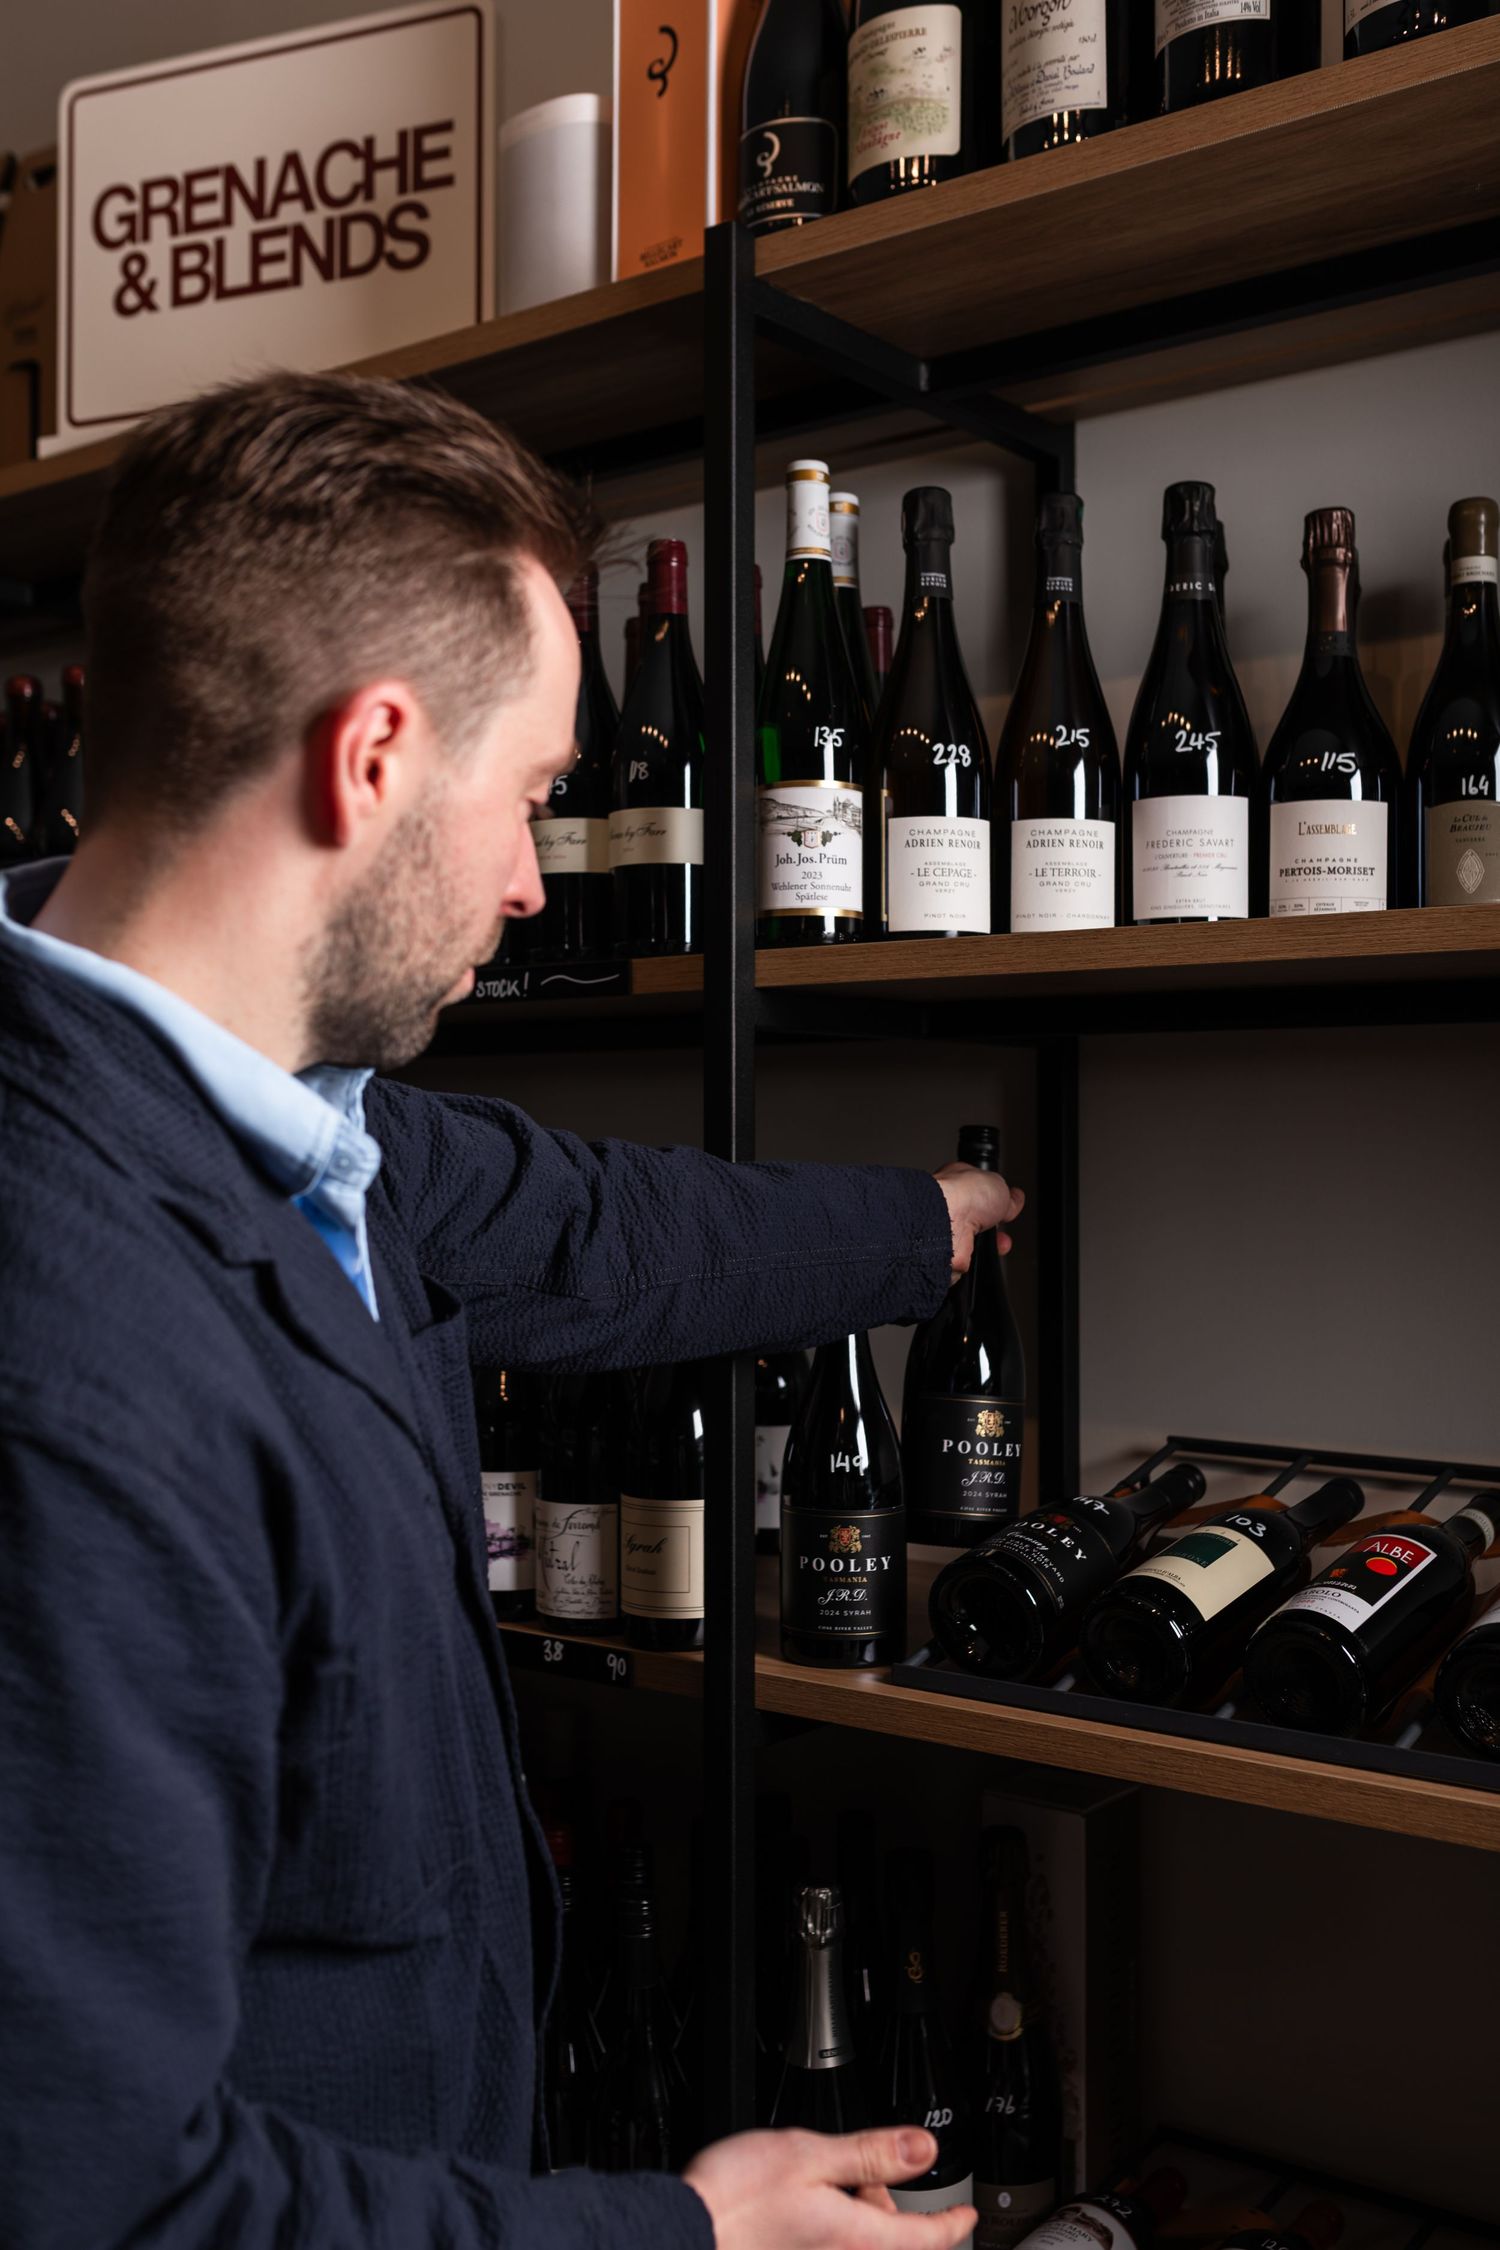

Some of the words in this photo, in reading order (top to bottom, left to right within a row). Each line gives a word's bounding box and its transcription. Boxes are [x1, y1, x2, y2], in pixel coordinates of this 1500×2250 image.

[92, 120, 455, 250] GRENACHE
[113, 251, 160, 319] &
[170, 201, 431, 308] BLENDS
[814, 726, 845, 747] 135
[1055, 725, 1090, 748] 215
[1174, 730, 1221, 753] 245
[932, 744, 971, 767] 228
[1320, 752, 1358, 773] 115
[1462, 774, 1489, 797] 164
[909, 829, 976, 837] CHAMPAGNE
[1030, 829, 1099, 837] CHAMPAGNE
[1298, 821, 1357, 836] L'ASSEMBLAGE
[904, 839, 944, 848] ADRIEN
[948, 839, 982, 849] RENOIR
[1026, 839, 1065, 848] ADRIEN
[1069, 839, 1105, 850] RENOIR
[1199, 838, 1234, 848] SAVART
[774, 853, 796, 868] Joh.
[796, 853, 817, 867] Jos.
[819, 853, 847, 865] Prüm
[801, 871, 823, 879] 2023
[917, 868, 930, 877] LE
[1035, 868, 1048, 877] LE
[1049, 867, 1096, 878] TERROIR
[1279, 866, 1375, 877] PERTOIS-MORISET
[771, 882, 807, 891] Wehlener
[942, 1439, 1022, 1457] POOLEY
[830, 1451, 865, 1476] 149
[968, 1458, 1006, 1466] TASMANIA
[1226, 1514, 1267, 1538] 103
[1014, 1521, 1087, 1560] OOLEY
[1363, 1541, 1415, 1564] ALBE
[799, 1555, 891, 1573] POOLEY
[843, 1609, 872, 1617] SYRAH
[543, 1639, 565, 1662] 38
[606, 1653, 627, 1680] 90
